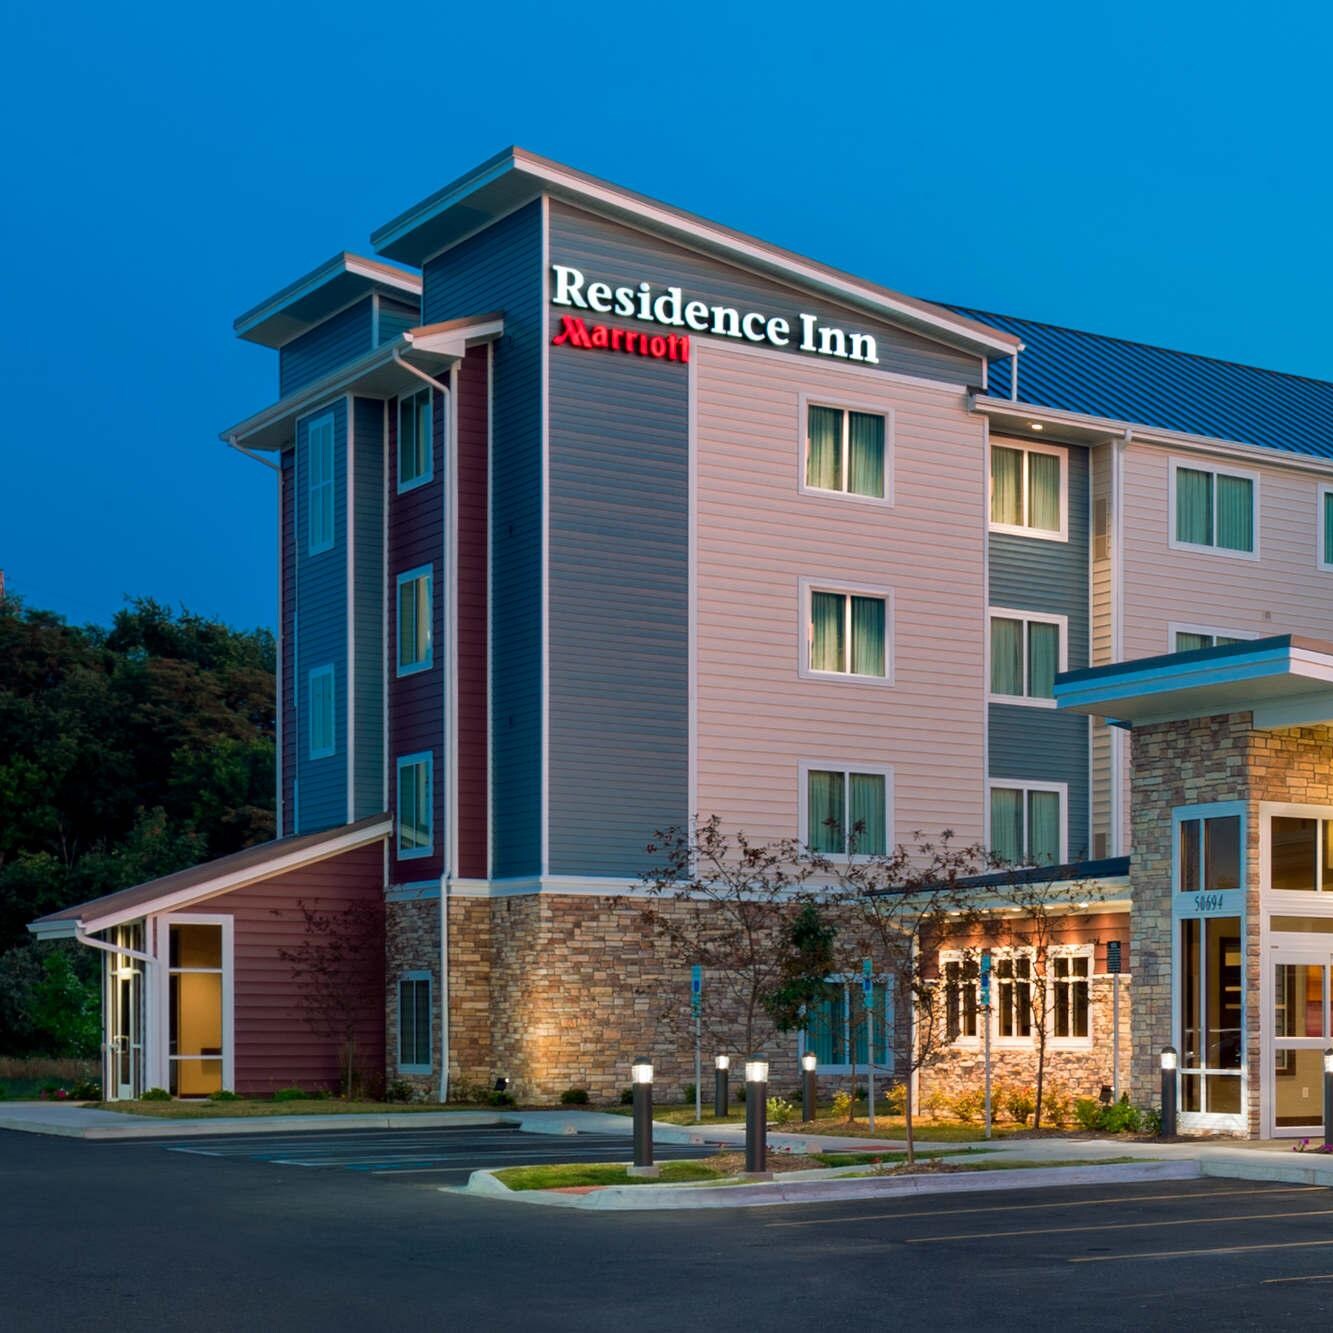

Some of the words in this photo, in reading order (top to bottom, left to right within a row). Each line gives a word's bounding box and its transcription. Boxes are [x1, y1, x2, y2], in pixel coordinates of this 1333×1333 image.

[552, 264, 790, 346] Residence
[799, 313, 879, 364] Inn
[552, 315, 690, 364] Marriott
[1194, 894, 1224, 912] 50694
